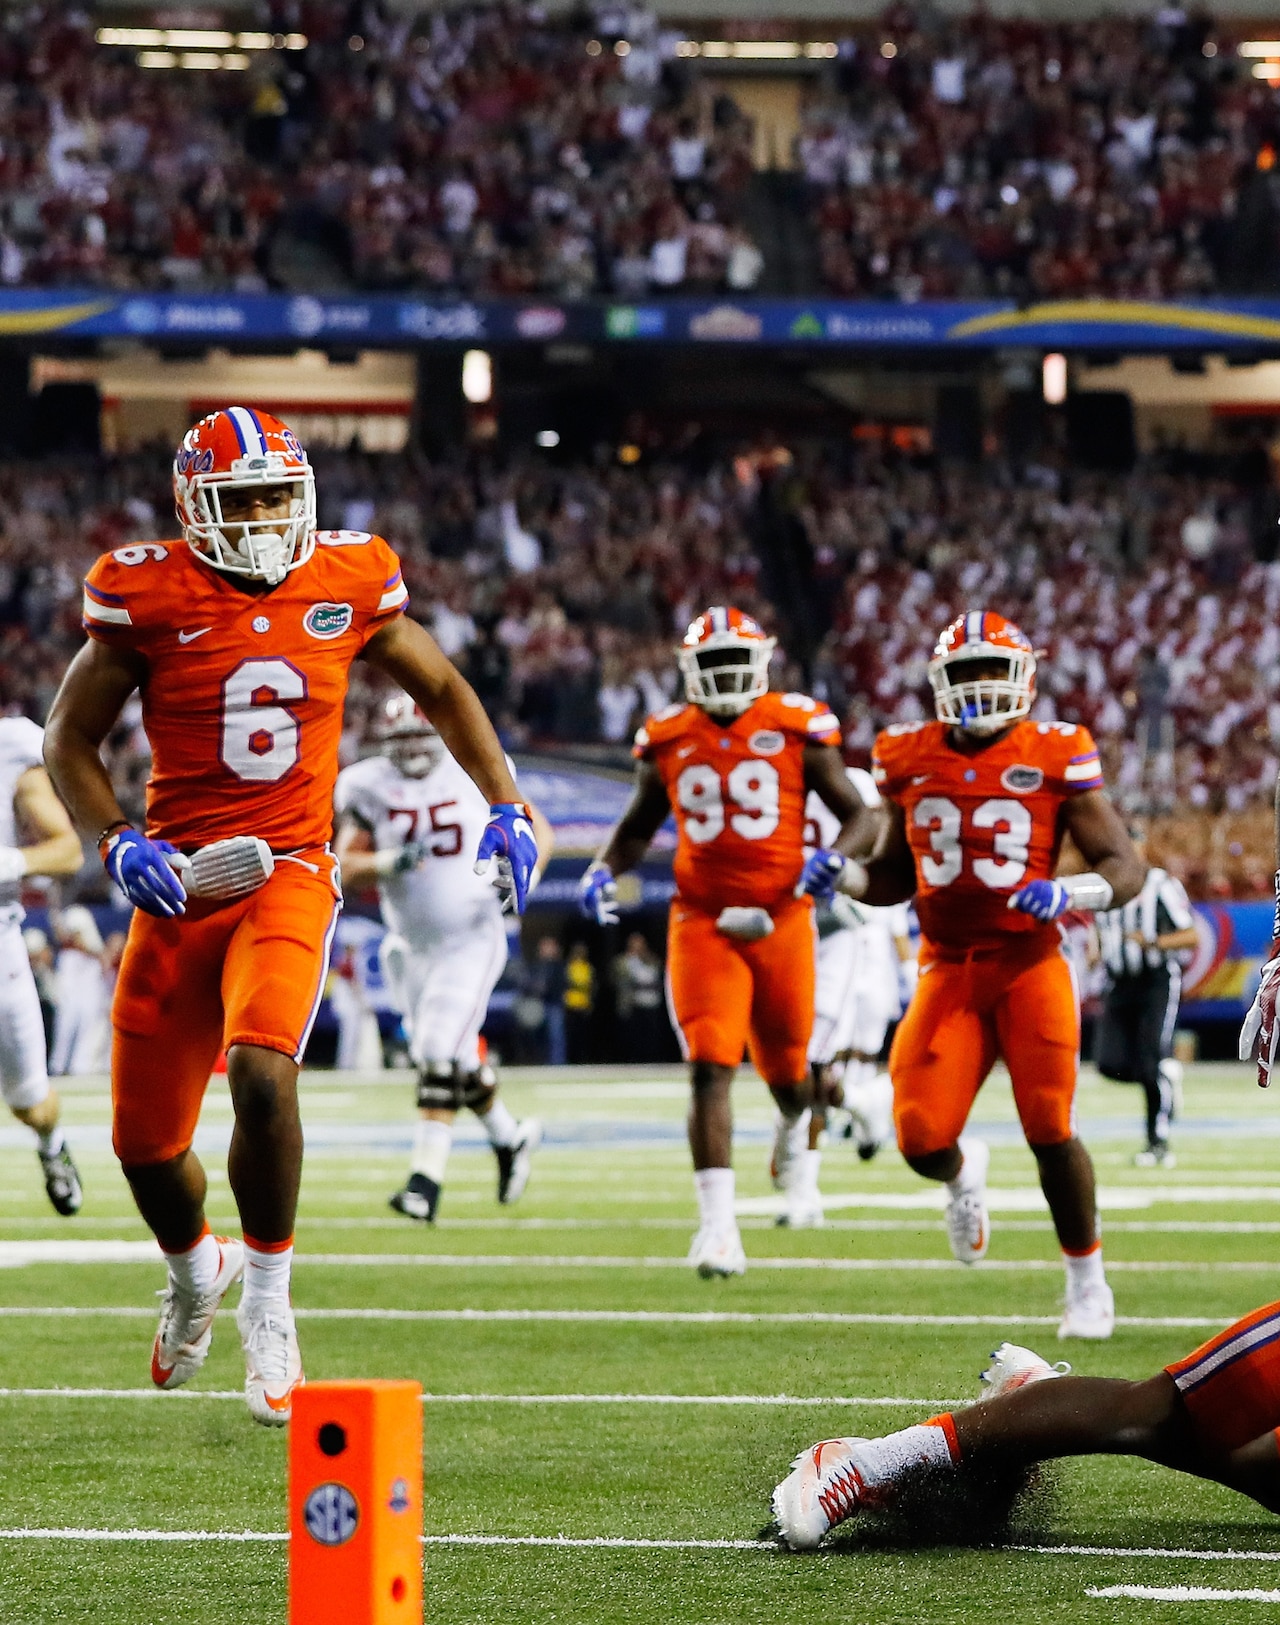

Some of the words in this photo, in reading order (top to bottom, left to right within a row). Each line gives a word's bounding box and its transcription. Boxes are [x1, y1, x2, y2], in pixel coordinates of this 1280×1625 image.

[112, 543, 169, 567] 6
[217, 655, 309, 784] 6
[388, 800, 463, 858] 75
[677, 758, 781, 844] 99
[912, 797, 1032, 889] 33
[304, 1483, 359, 1546] SEC
